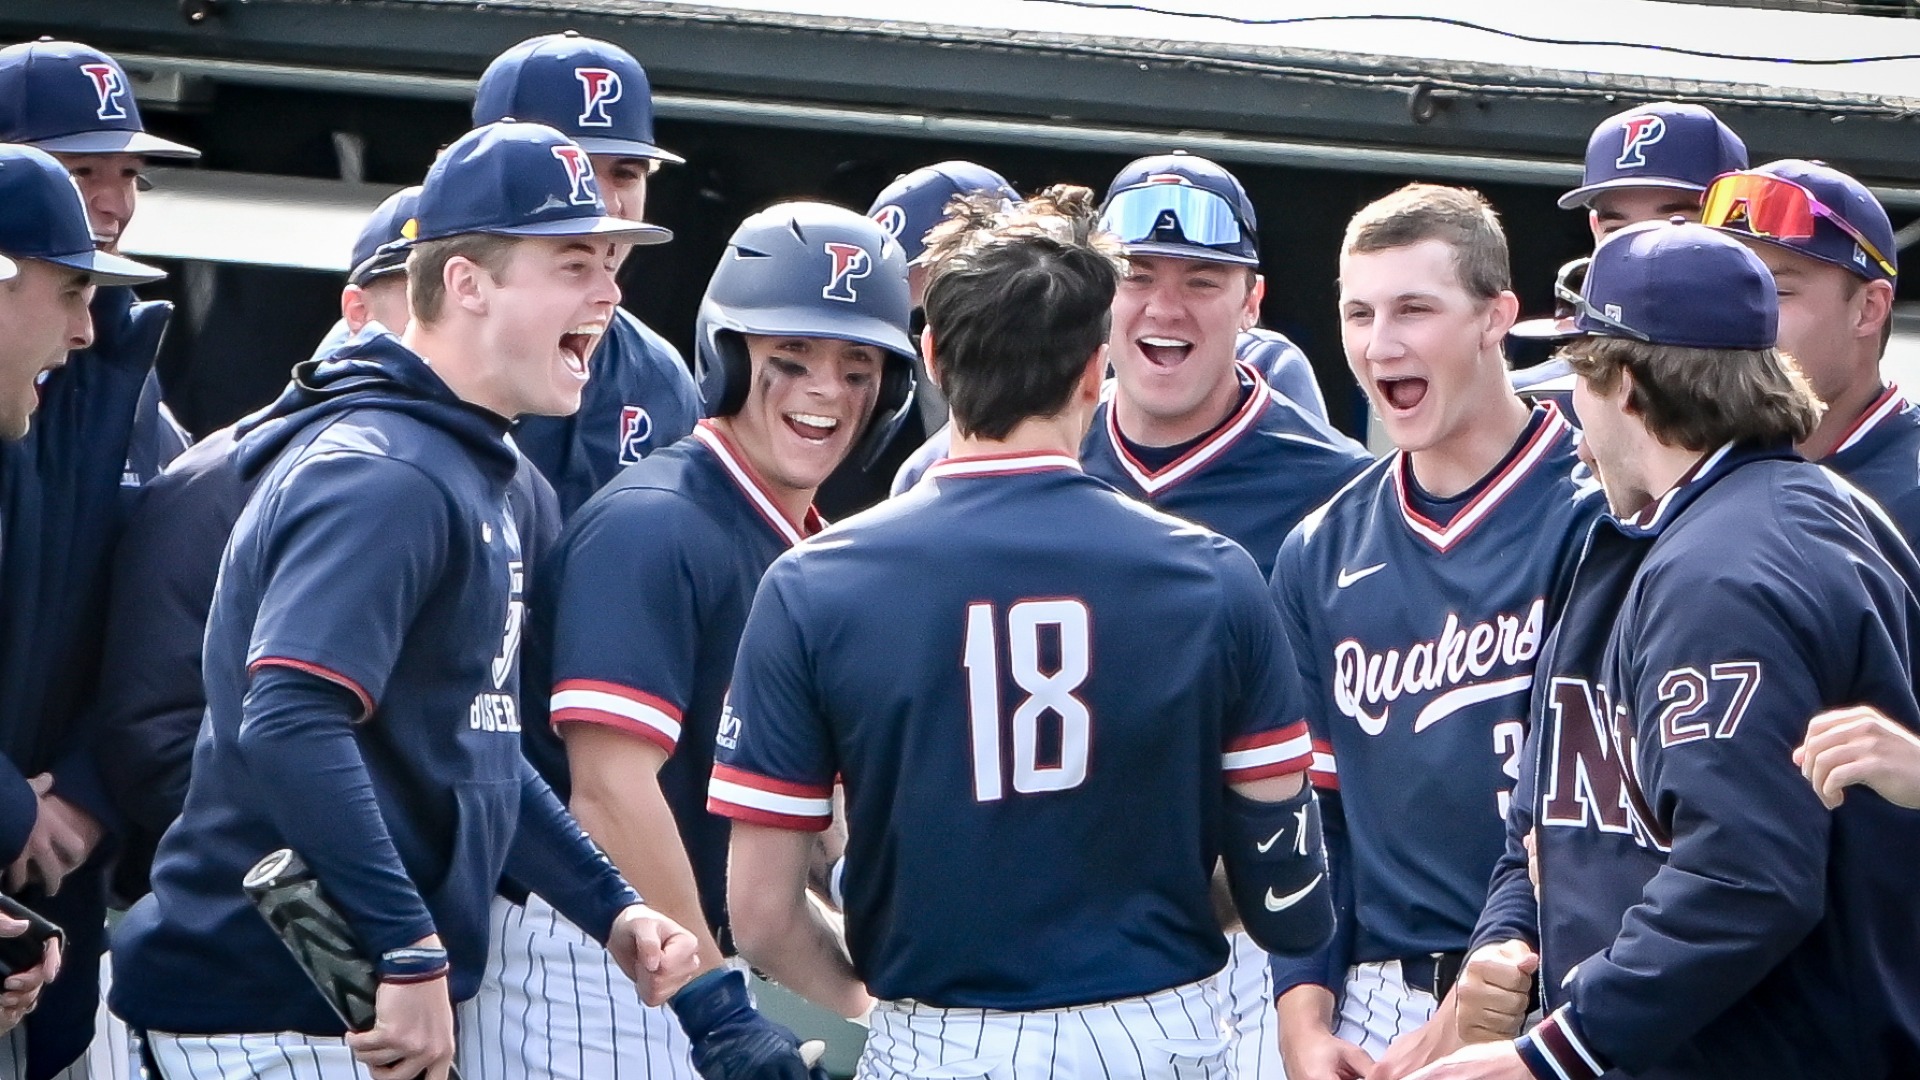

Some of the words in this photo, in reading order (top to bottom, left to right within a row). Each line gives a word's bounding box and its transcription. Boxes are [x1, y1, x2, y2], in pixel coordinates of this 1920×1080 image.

[80, 64, 126, 119] P
[575, 67, 622, 127] P
[1615, 114, 1666, 169] P
[551, 144, 597, 205] P
[823, 242, 872, 302] P
[619, 405, 652, 466] P
[1333, 598, 1545, 736] Quakers
[963, 598, 1091, 802] 18
[1658, 661, 1761, 748] 27
